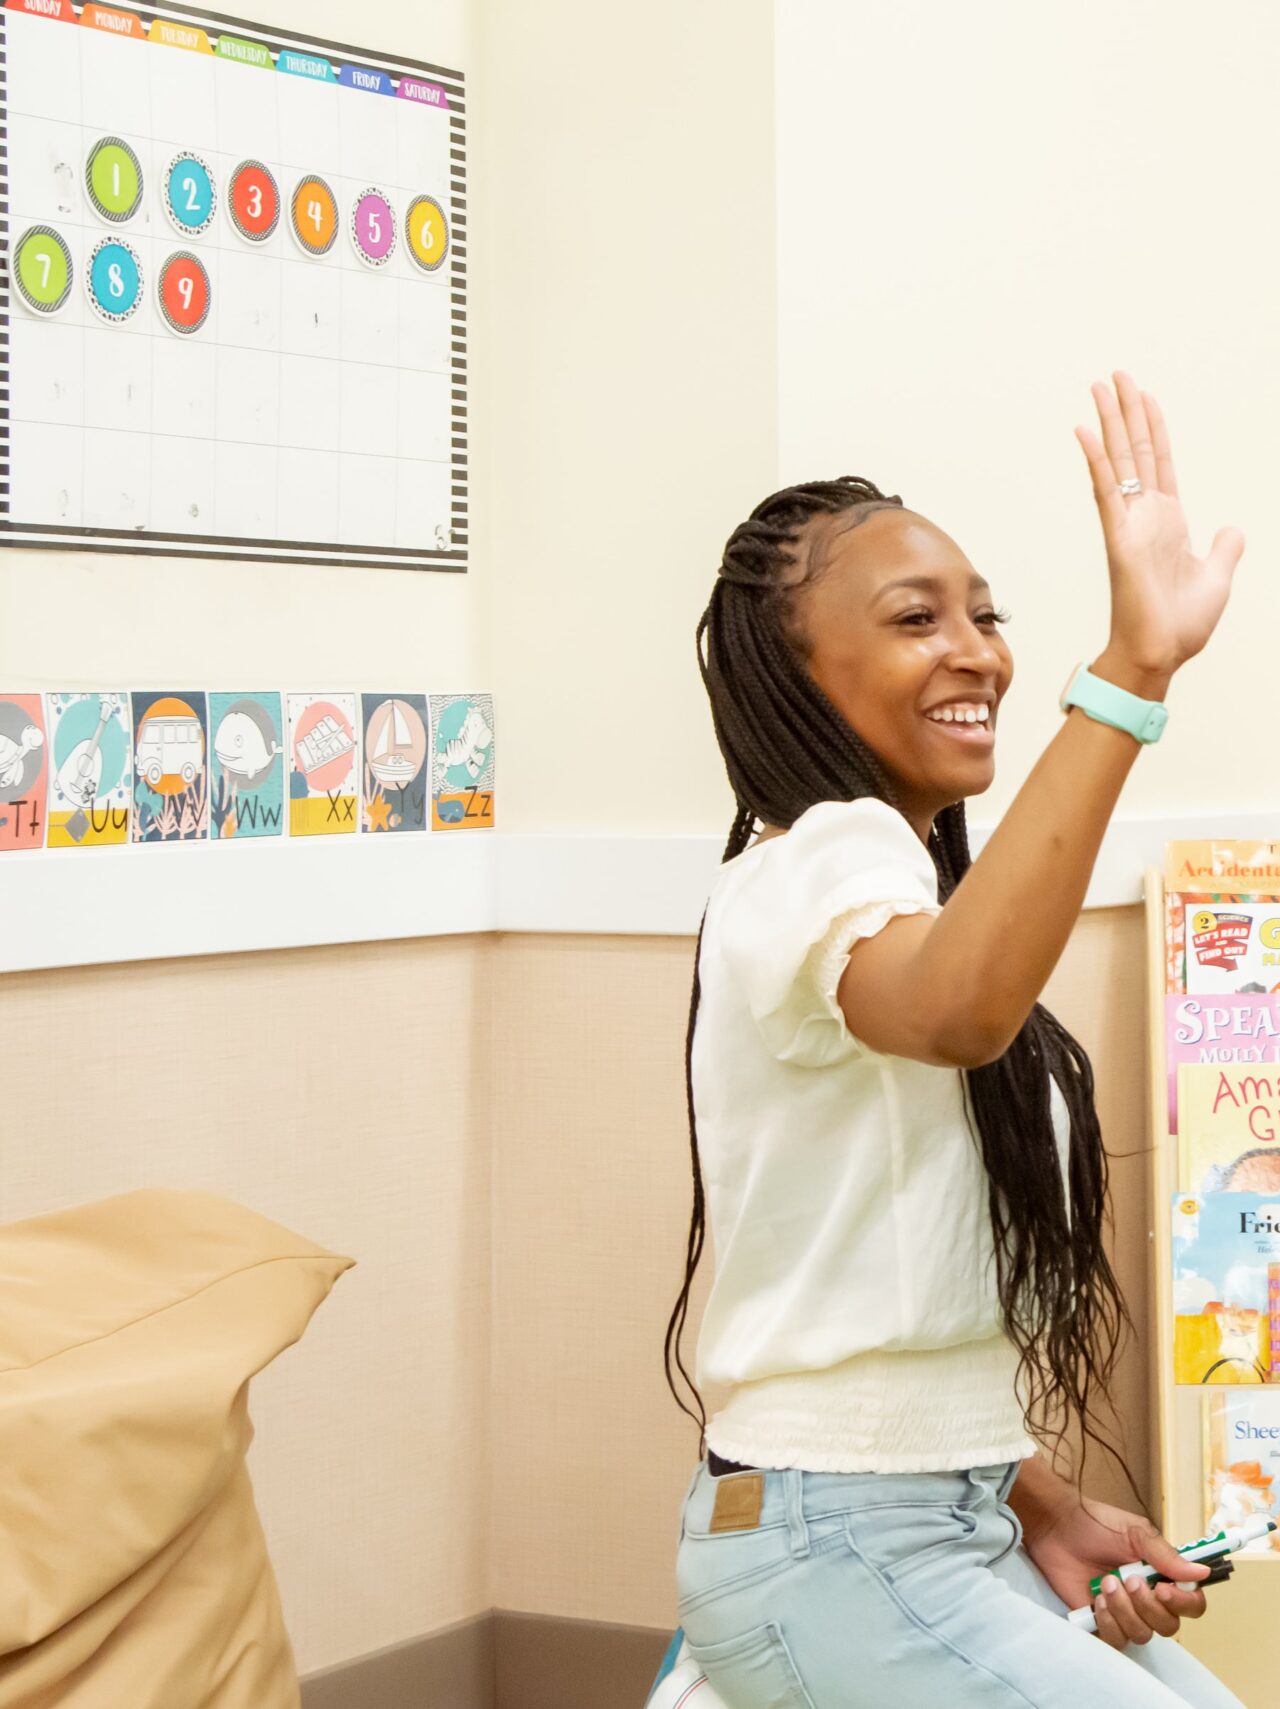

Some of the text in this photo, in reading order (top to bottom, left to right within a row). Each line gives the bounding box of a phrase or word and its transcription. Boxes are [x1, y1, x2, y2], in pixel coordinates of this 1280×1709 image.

[95, 11, 133, 34] MONDAY
[160, 25, 199, 48] TUESDAY
[219, 39, 267, 65] WEDNESDAY
[285, 55, 329, 78] THURSDAY
[352, 71, 381, 91] FRIDAY
[404, 82, 441, 104] SATURDAY
[112, 162, 120, 196] 1
[184, 177, 201, 211] 2
[247, 185, 262, 218] 3
[307, 200, 323, 232] 4
[368, 212, 381, 243] 5
[421, 220, 434, 249] 6
[35, 254, 51, 288] 7
[109, 263, 125, 297] 8
[178, 276, 194, 309] 9
[91, 797, 128, 833] Uu
[235, 795, 281, 829] Ww
[326, 789, 356, 823] Xx
[395, 781, 424, 824] Yy
[464, 786, 491, 817] Zz
[1200, 917, 1209, 929] 2
[1220, 927, 1249, 938] READ
[1223, 946, 1245, 955] OUT
